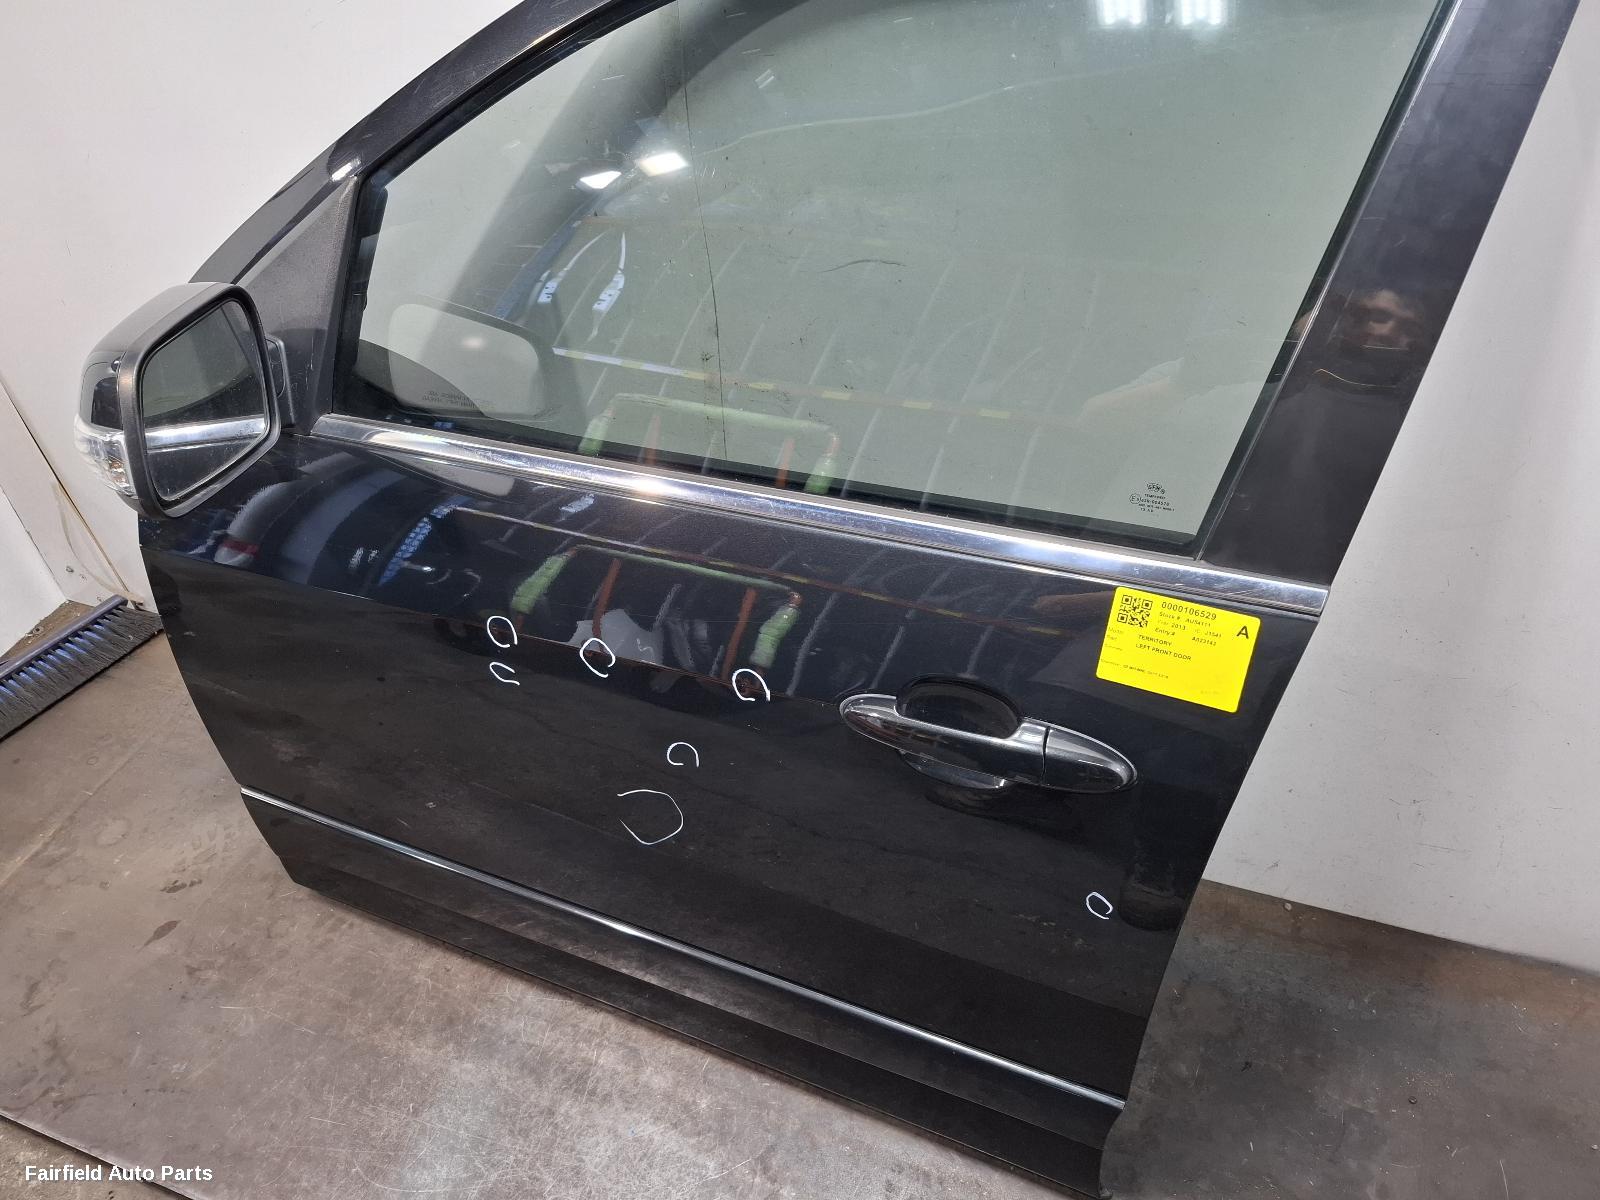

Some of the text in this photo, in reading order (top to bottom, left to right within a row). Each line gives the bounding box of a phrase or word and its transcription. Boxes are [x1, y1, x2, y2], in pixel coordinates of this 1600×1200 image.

[1161, 601, 1217, 621] 0000106529
[1138, 634, 1173, 647] TERRITORY
[1236, 625, 1250, 640] A
[1135, 643, 1192, 661] LEFT FRONT DOOR
